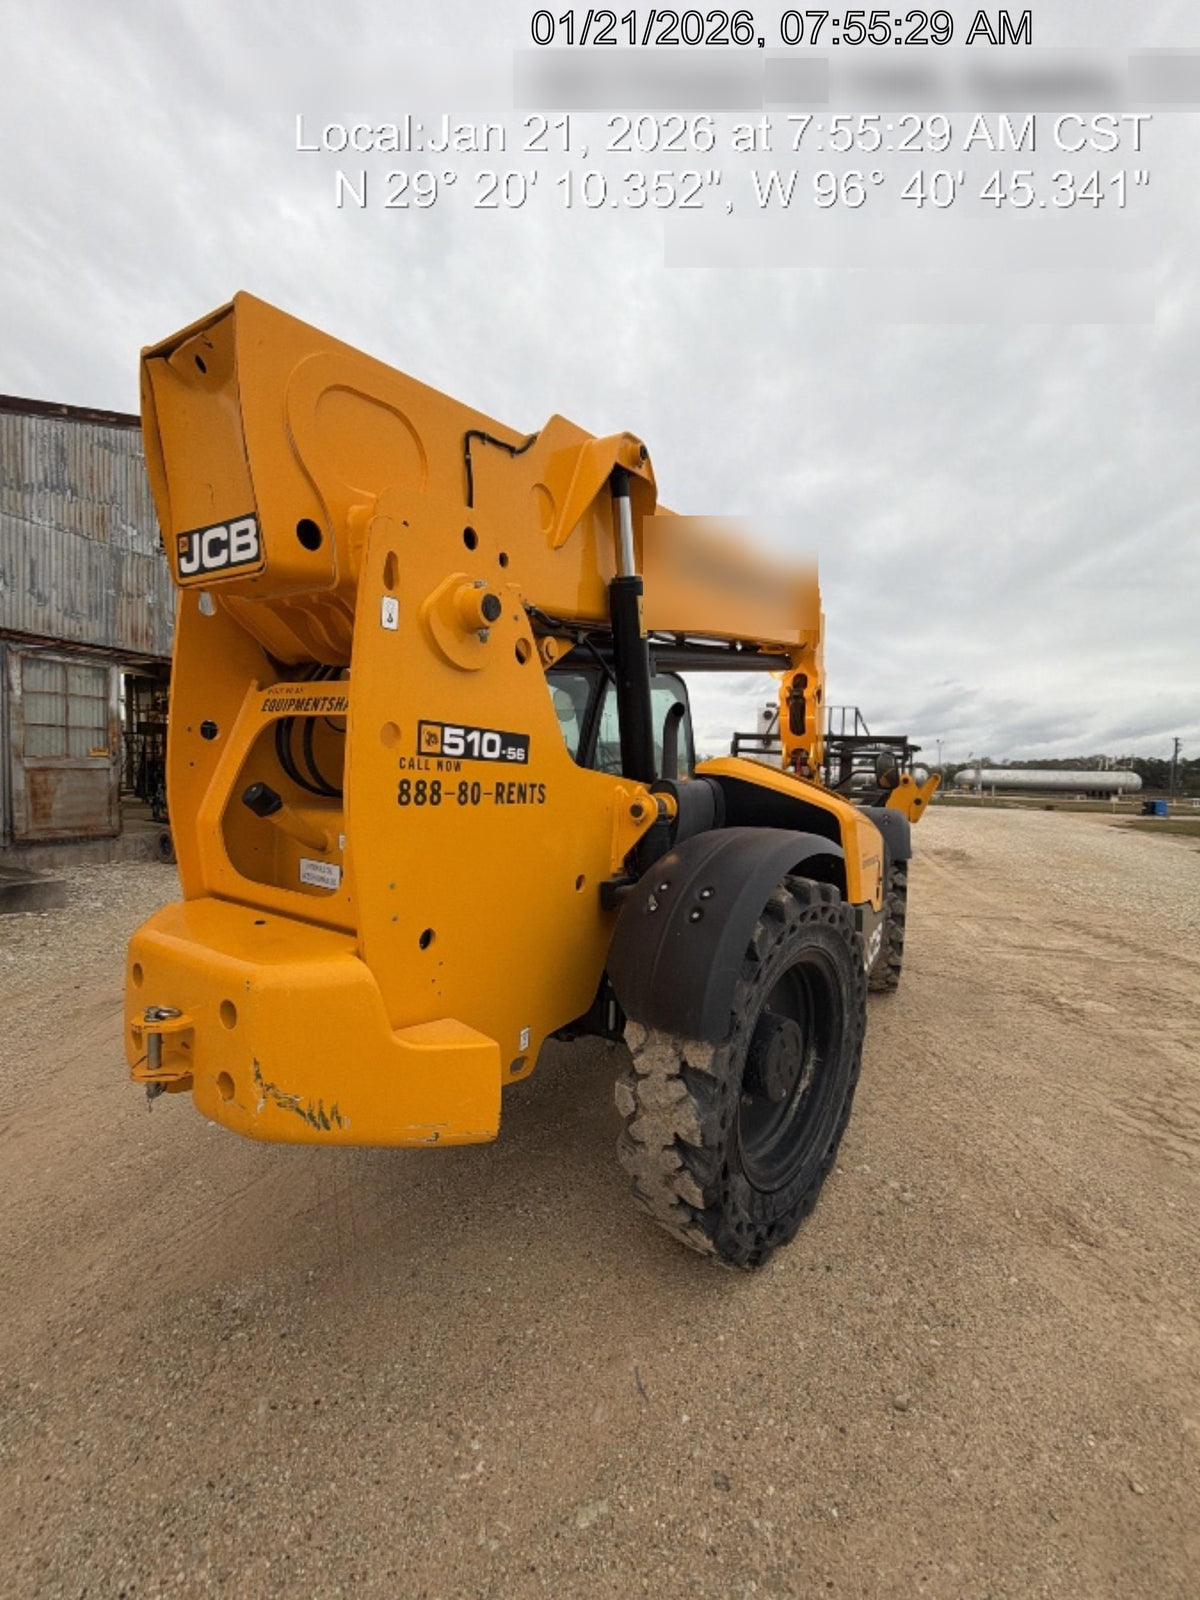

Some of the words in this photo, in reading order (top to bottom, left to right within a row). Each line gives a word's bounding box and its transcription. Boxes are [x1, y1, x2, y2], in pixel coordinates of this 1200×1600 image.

[180, 518, 259, 574] JCB
[399, 757, 431, 771] CALL
[437, 760, 463, 773] NOW
[397, 778, 547, 807] 888-80-RENTS
